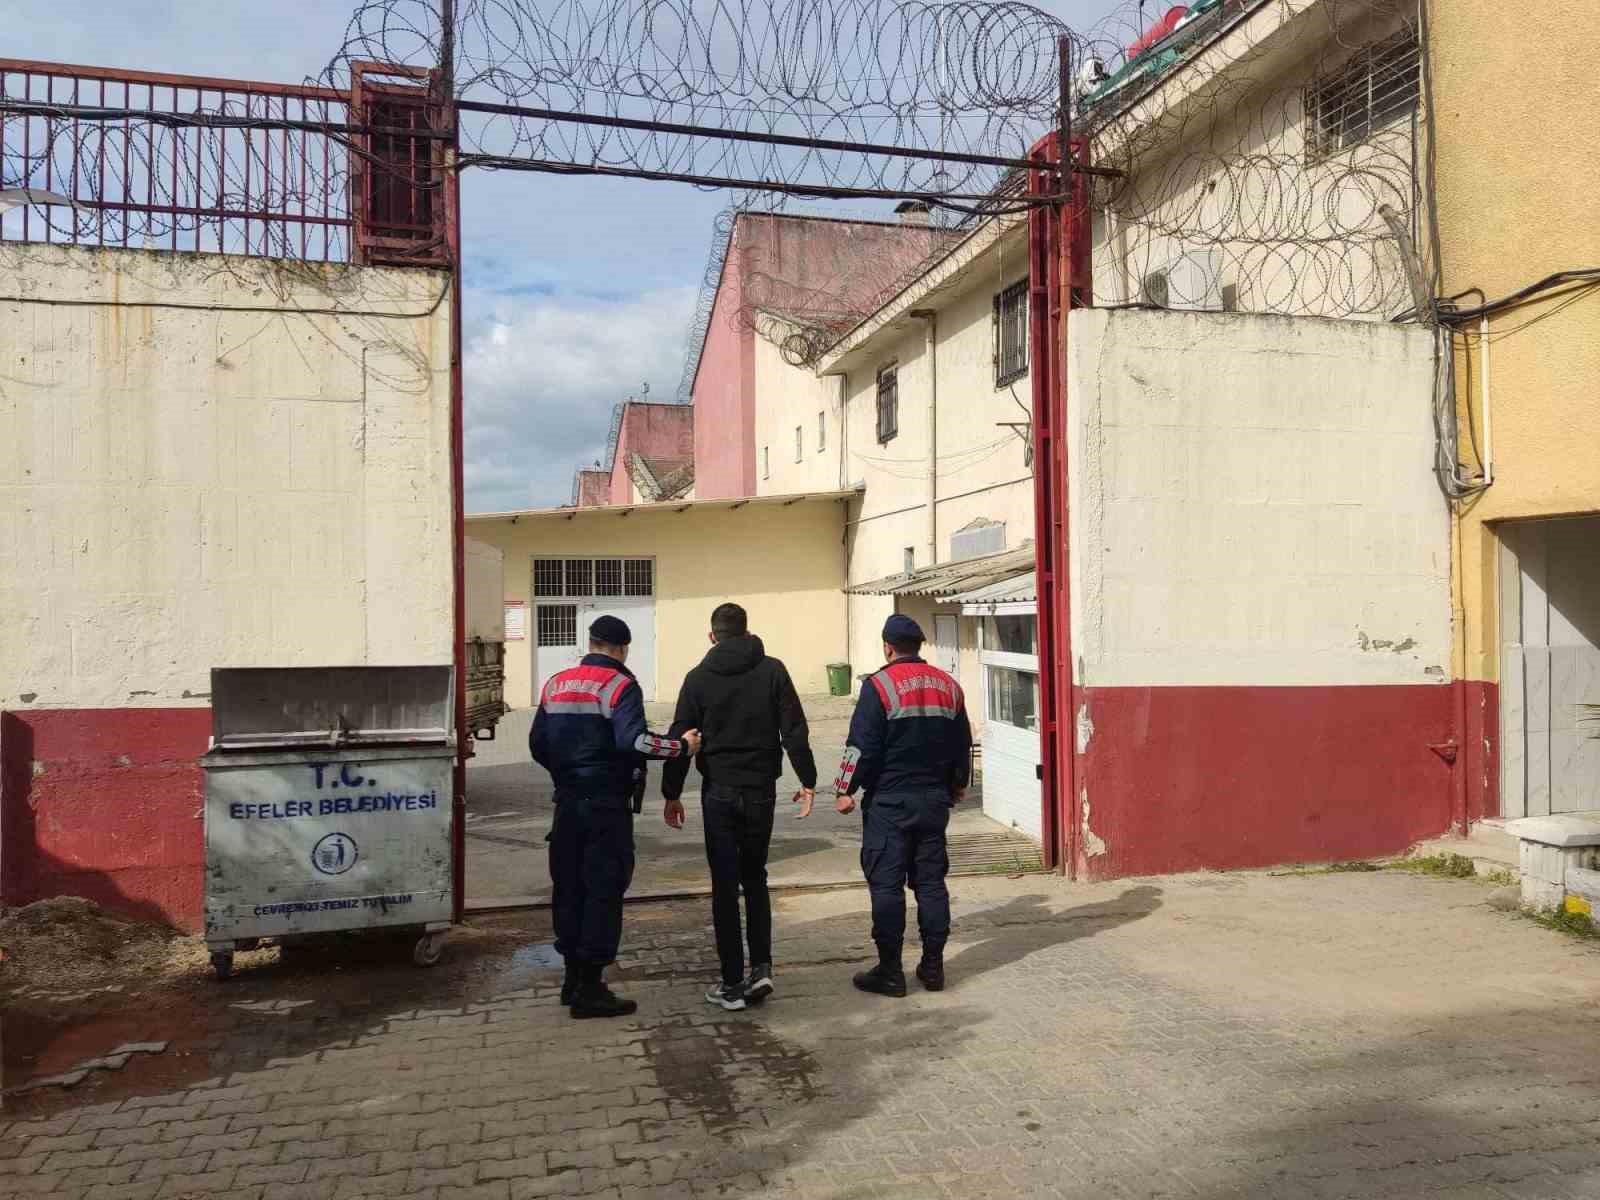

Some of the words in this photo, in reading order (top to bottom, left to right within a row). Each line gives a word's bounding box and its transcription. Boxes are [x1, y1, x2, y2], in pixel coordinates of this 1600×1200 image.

[308, 762, 377, 789] T.C.
[230, 801, 313, 820] EFELER
[319, 790, 436, 816] BELEDİYESİ
